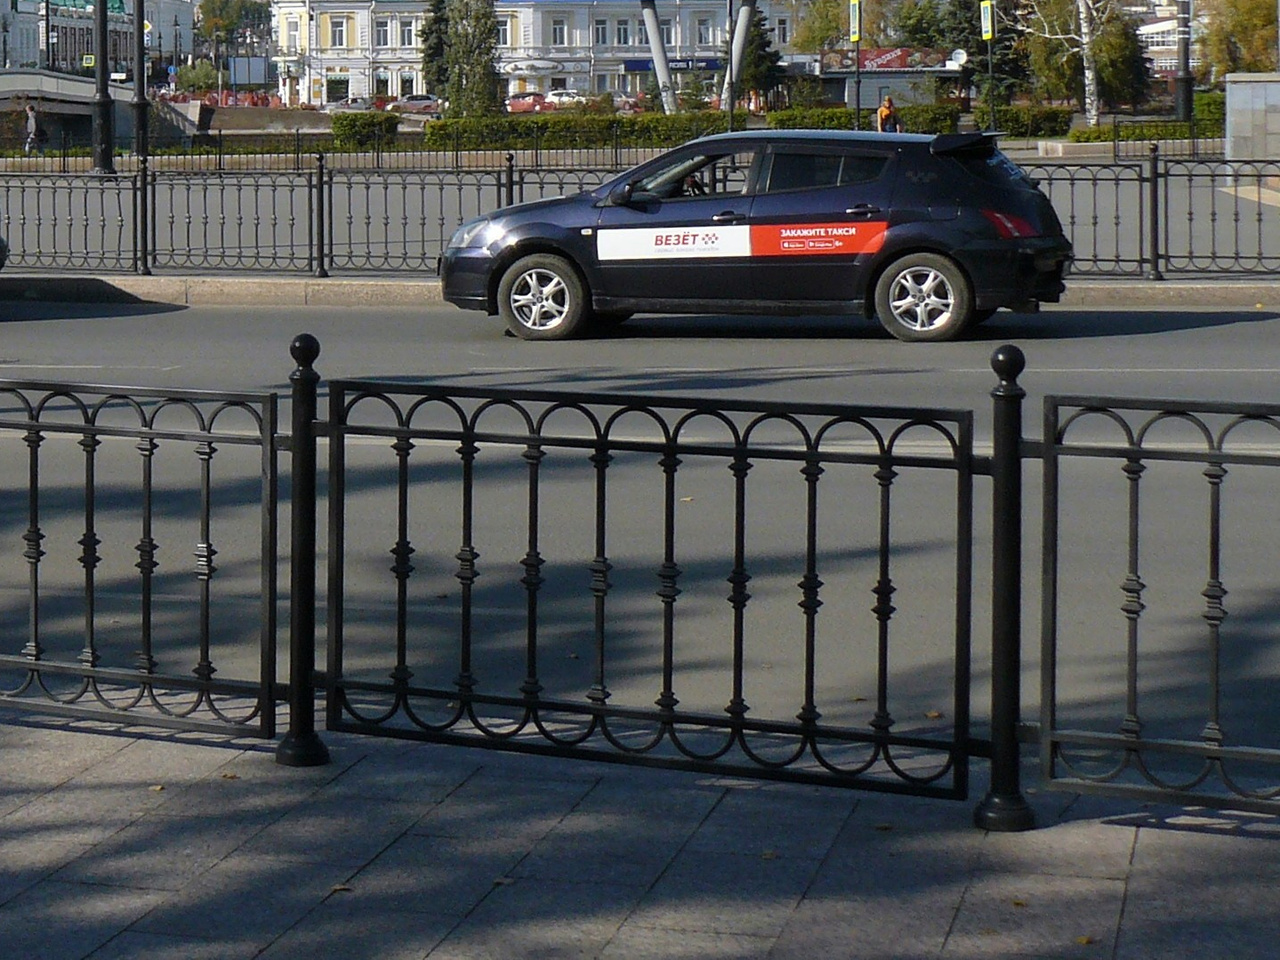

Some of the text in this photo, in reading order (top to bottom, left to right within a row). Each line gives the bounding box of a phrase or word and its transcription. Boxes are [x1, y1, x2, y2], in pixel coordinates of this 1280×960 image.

[780, 227, 856, 237] ЗАКАЖИТЕ ТАКСИ
[655, 231, 699, 246] ВЕЗЁТ
